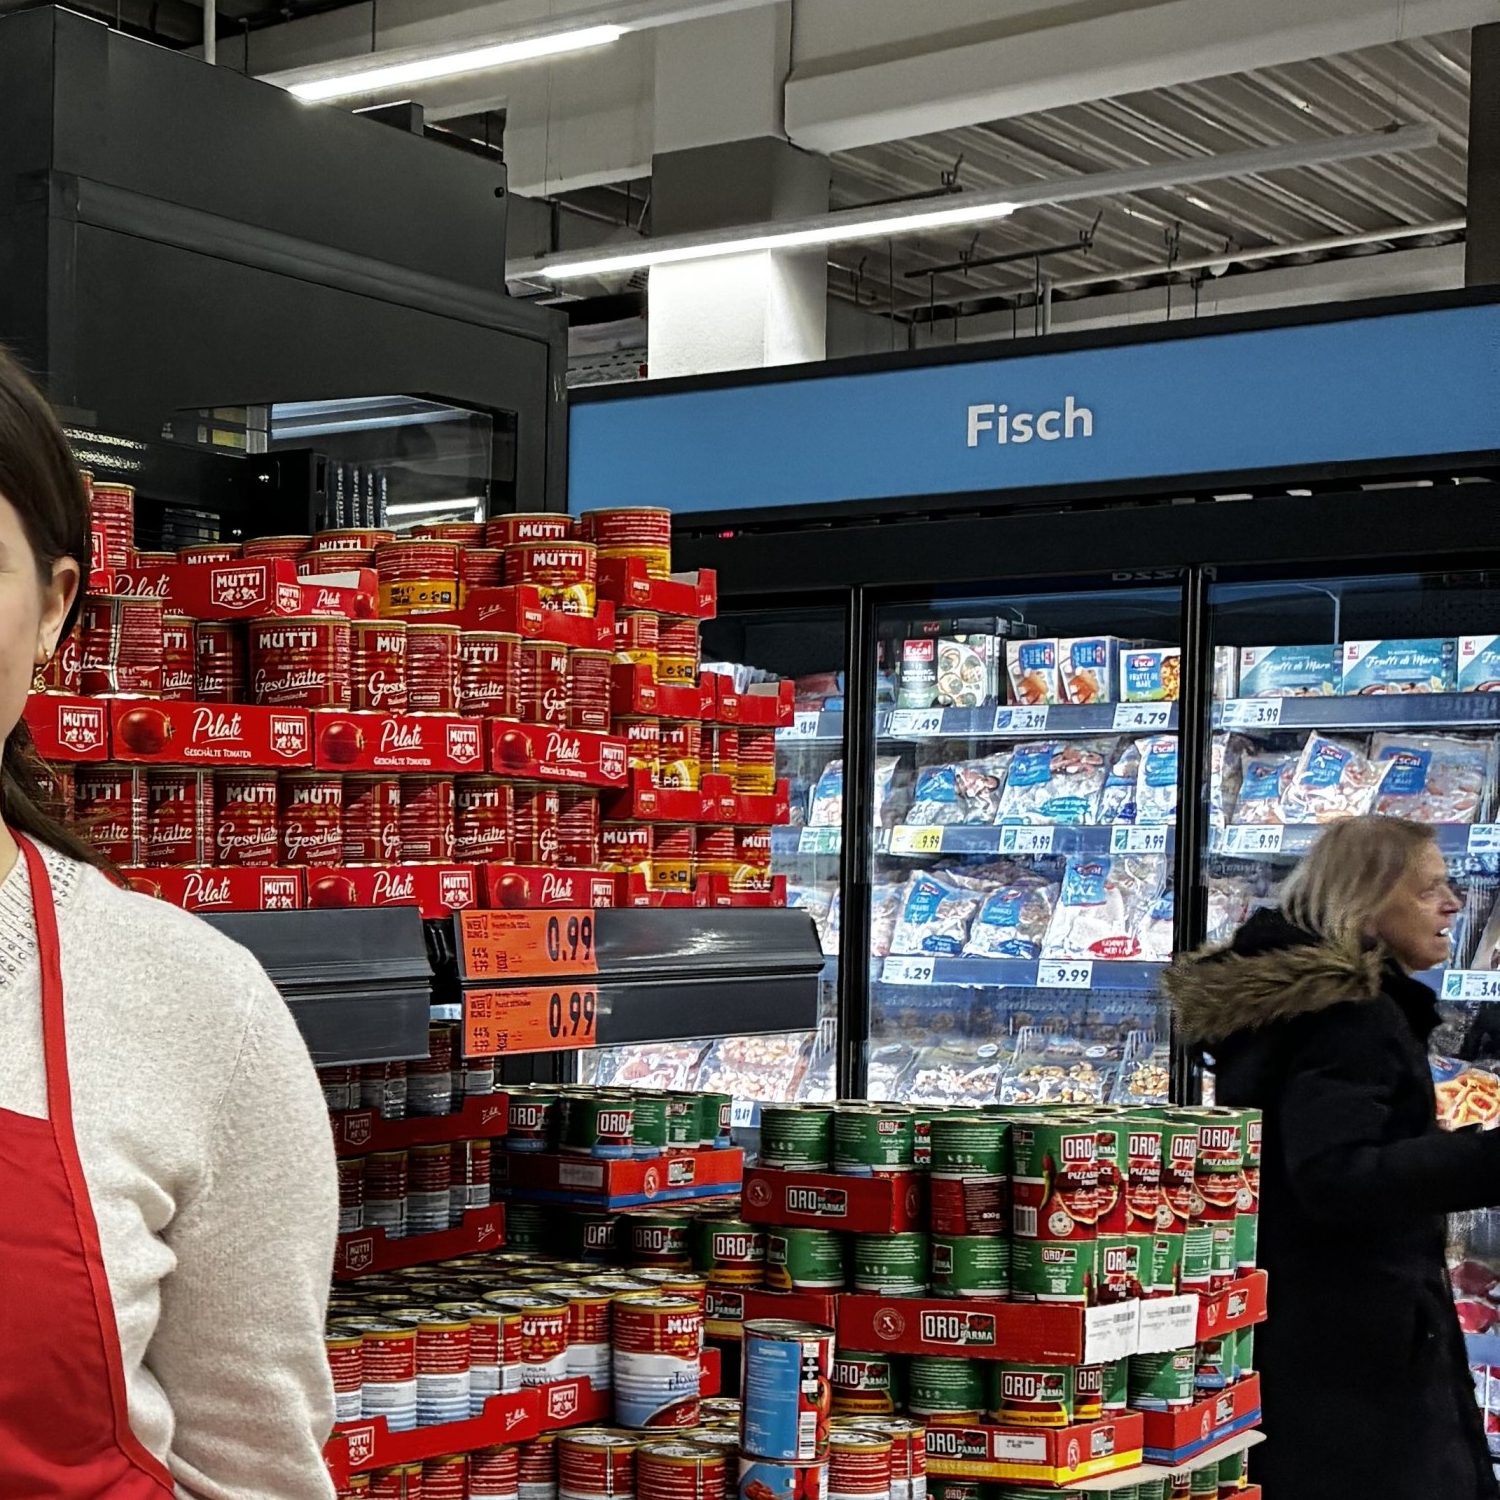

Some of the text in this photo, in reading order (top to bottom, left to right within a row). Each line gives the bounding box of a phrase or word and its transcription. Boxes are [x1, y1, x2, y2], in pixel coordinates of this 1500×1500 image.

[966, 396, 1095, 447] Fisch
[519, 524, 565, 538] MUTTI
[533, 553, 582, 567] MUTTI
[217, 573, 260, 588] MUTTI
[259, 632, 317, 648] MUTTI
[906, 646, 931, 656] Escal
[255, 668, 325, 705] Geschälte
[63, 713, 98, 727] MUTTI
[1026, 714, 1044, 726] 2.99
[1134, 712, 1167, 725] 4.79
[1257, 708, 1278, 722] 3.99
[192, 708, 243, 743] Pelati
[274, 721, 304, 734] MUTTI
[381, 720, 423, 752] Pelati
[450, 730, 476, 743] MUTTI
[184, 747, 251, 758] GESCHÄLTE TOMATEN
[546, 732, 580, 762] Pelati
[603, 832, 647, 844] MUTTI
[922, 835, 940, 848] 9.99
[1032, 836, 1050, 849] 9.99
[1146, 834, 1164, 848] 9.99
[1259, 834, 1279, 849] 9.99
[264, 882, 294, 894] MUTTI
[373, 871, 415, 904] Pelati
[443, 877, 467, 888] MUTTI
[183, 873, 233, 909] Pelati
[548, 916, 592, 962] 0.99
[1057, 969, 1089, 981] 9.99
[549, 992, 594, 1038] 0.99
[509, 1107, 536, 1125] ORO
[601, 1114, 626, 1133] ORO
[1130, 1136, 1154, 1154] ORO
[1203, 1129, 1229, 1148] ORO
[1065, 1139, 1091, 1159] ORO
[716, 1236, 746, 1257] ORO
[926, 1316, 959, 1339] ORO
[960, 1331, 993, 1340] PARMA
